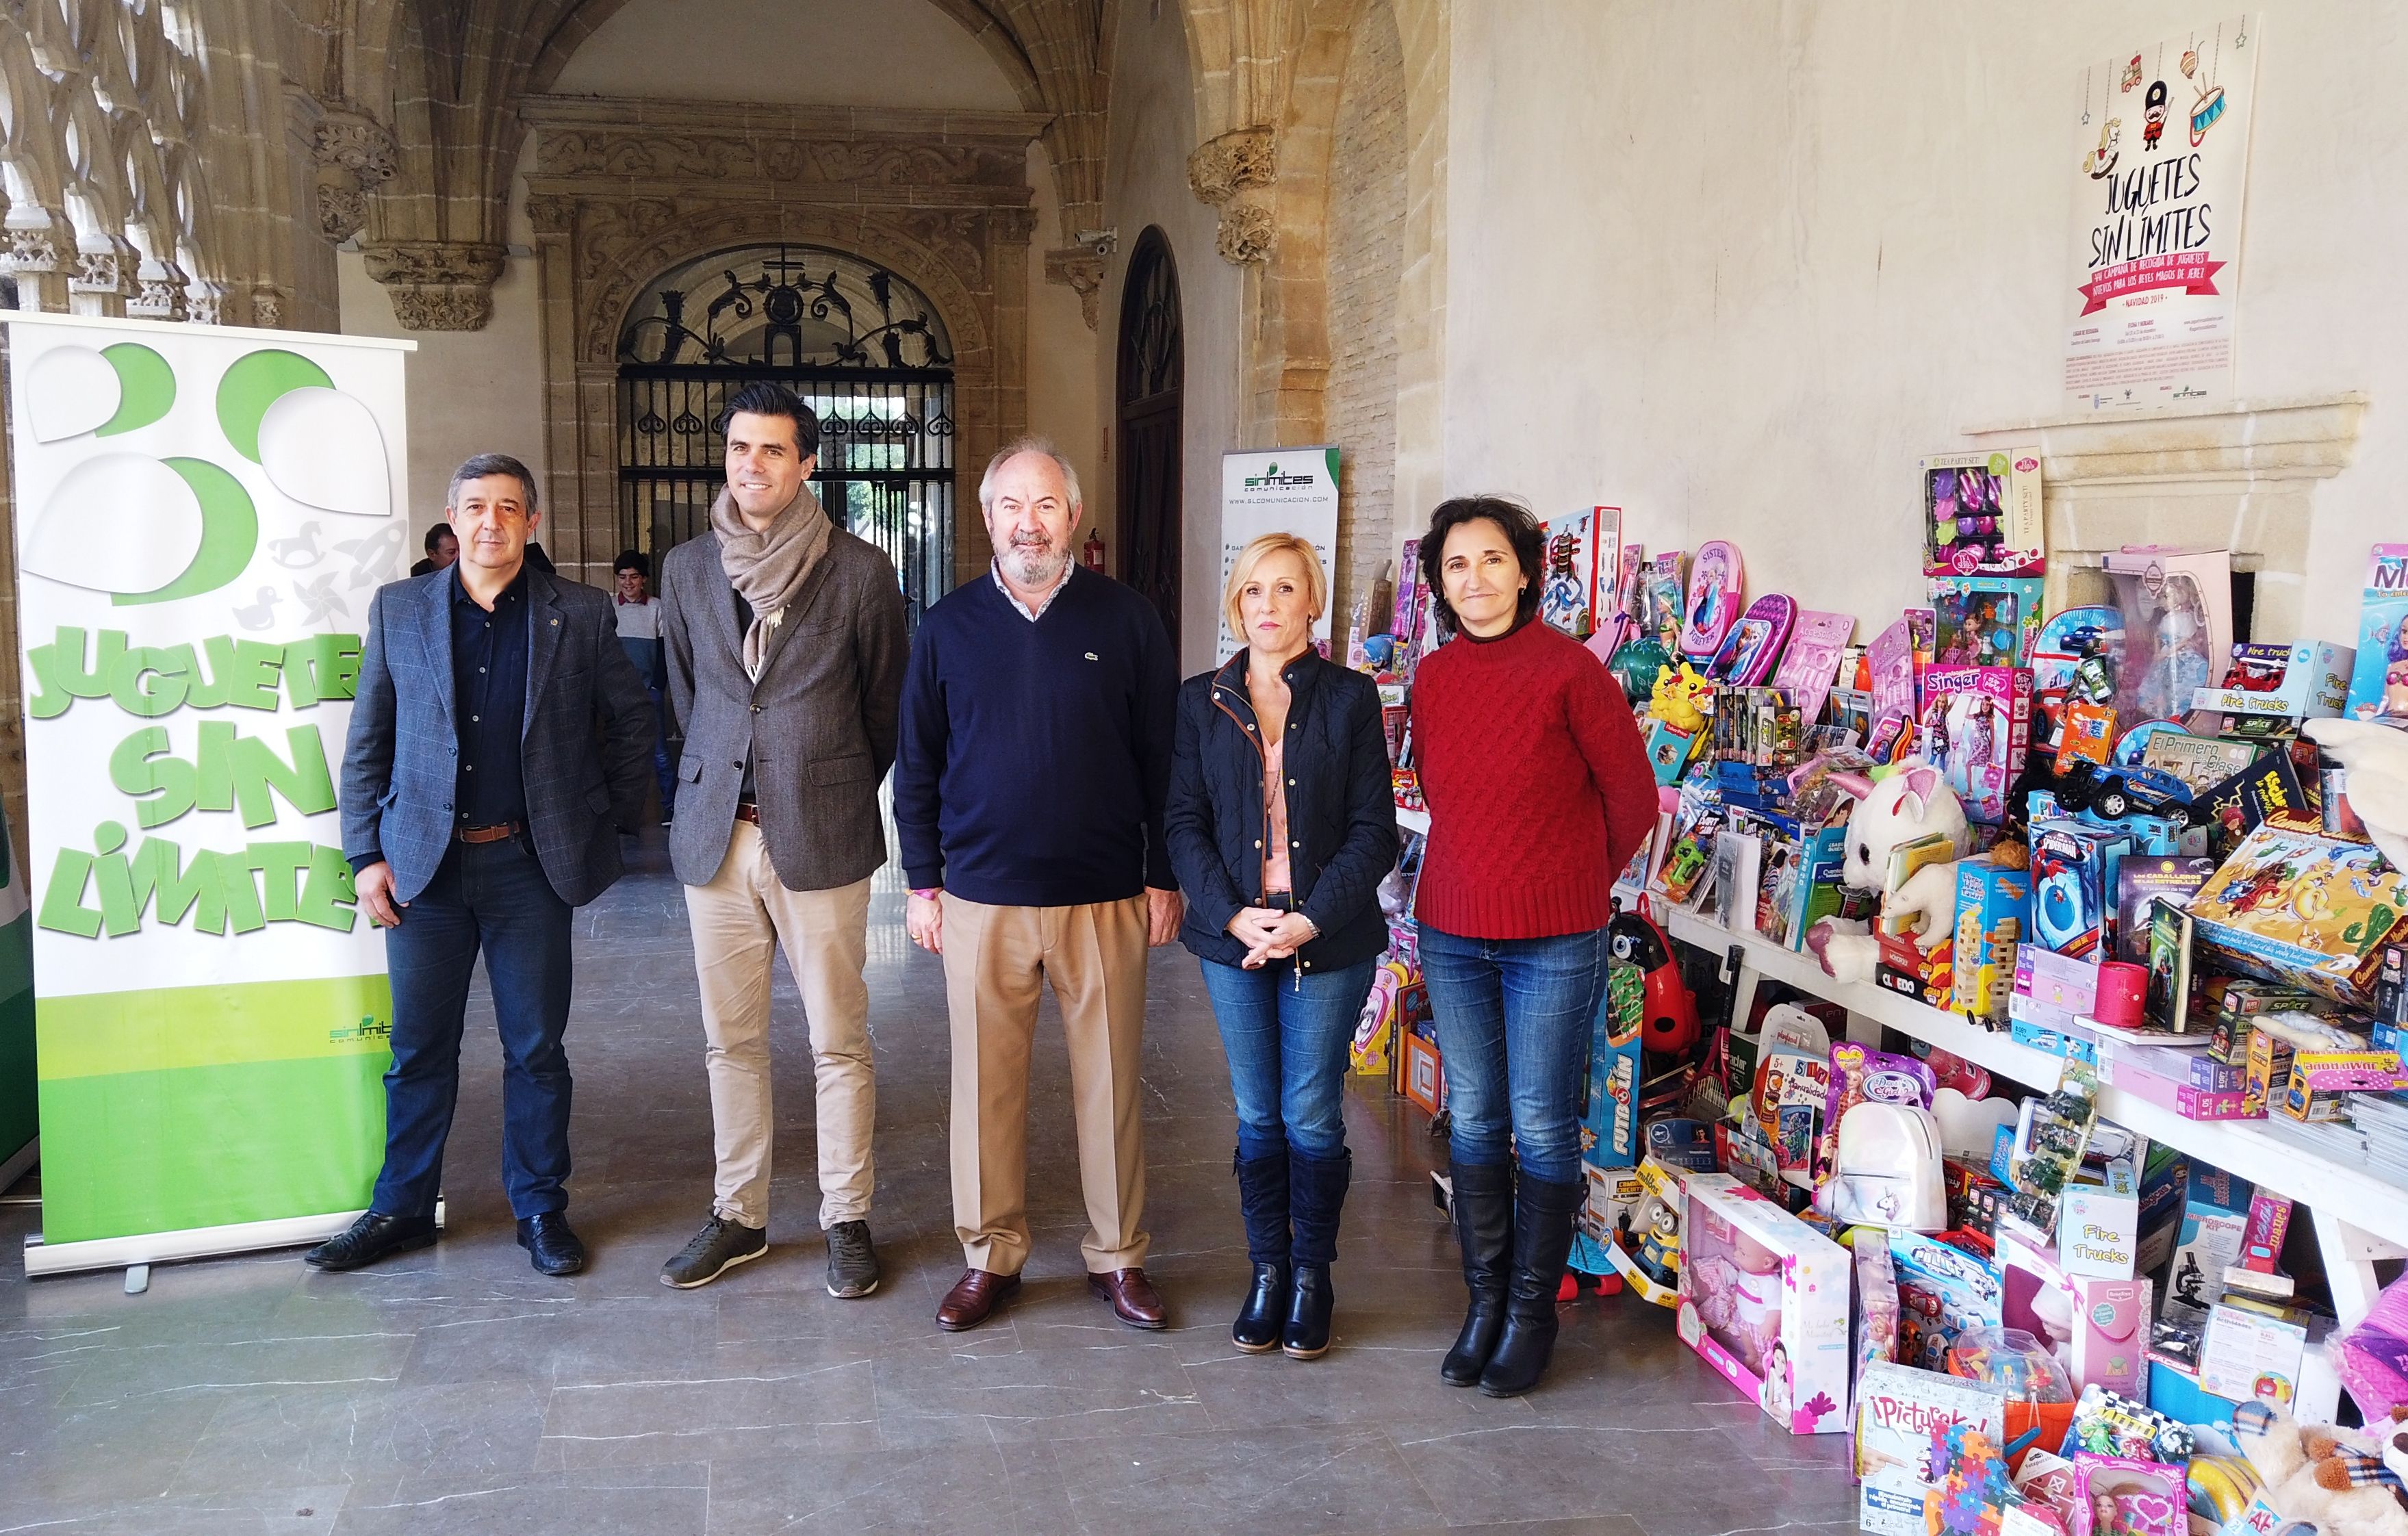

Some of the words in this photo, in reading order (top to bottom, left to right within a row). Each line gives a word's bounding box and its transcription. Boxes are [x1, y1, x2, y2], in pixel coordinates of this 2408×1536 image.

[2105, 153, 2201, 216] JUGUETES
[2088, 215, 2124, 268] SIN
[2127, 203, 2212, 261] LÍMITES
[2130, 261, 2137, 272] DE
[2139, 255, 2165, 270] RECOGIDA
[2166, 255, 2173, 266] DE
[2176, 253, 2205, 266] JUGUETES
[2092, 281, 2112, 297] NUEVOS
[2113, 278, 2125, 291] PARA
[2127, 276, 2136, 286] LOS
[2138, 272, 2154, 284] REYES
[2155, 270, 2175, 281] MAGOS
[2177, 268, 2184, 279] DE
[2187, 267, 2205, 279] JEREZ
[2125, 296, 2149, 307] NAVIDAD
[2150, 294, 2164, 305] 2019
[1941, 457, 1950, 465] TEA
[1951, 457, 1967, 465] PARTY
[1799, 626, 1841, 641] Accesorios
[2247, 647, 2265, 656] Fire
[2268, 648, 2290, 658] truck
[26, 625, 368, 719] JUGUETE
[1927, 673, 1981, 694] Singer
[2325, 673, 2348, 691] Fire
[2220, 693, 2244, 708] Fire
[2249, 696, 2289, 713] trucks
[2316, 691, 2346, 710] Truck
[1665, 724, 1689, 738] Fisher-Price
[2153, 737, 2165, 751] El
[2164, 736, 2219, 756] Primero
[2207, 755, 2242, 774] Clase
[108, 719, 337, 830] SIN
[1698, 817, 1719, 826] DART
[2045, 834, 2076, 845] ULTIMATE
[37, 820, 370, 939] LÍMITE
[2270, 1001, 2310, 1011] SPACE
[1776, 1030, 1797, 1045] playland
[1774, 1058, 1784, 1068] 5+
[2202, 1097, 2210, 1108] 50
[1637, 1172, 1660, 1196] minions
[2186, 1212, 2242, 1232] MICROSCOPE
[2205, 1223, 2220, 1231] KIT
[2083, 1224, 2121, 1242] Fire
[2073, 1243, 2129, 1265] Trucks
[1914, 1250, 1963, 1279] POLICE
[2216, 1316, 2251, 1330] Actividades
[2147, 1352, 2192, 1372] RACING
[2096, 1405, 2157, 1440] MOTO
